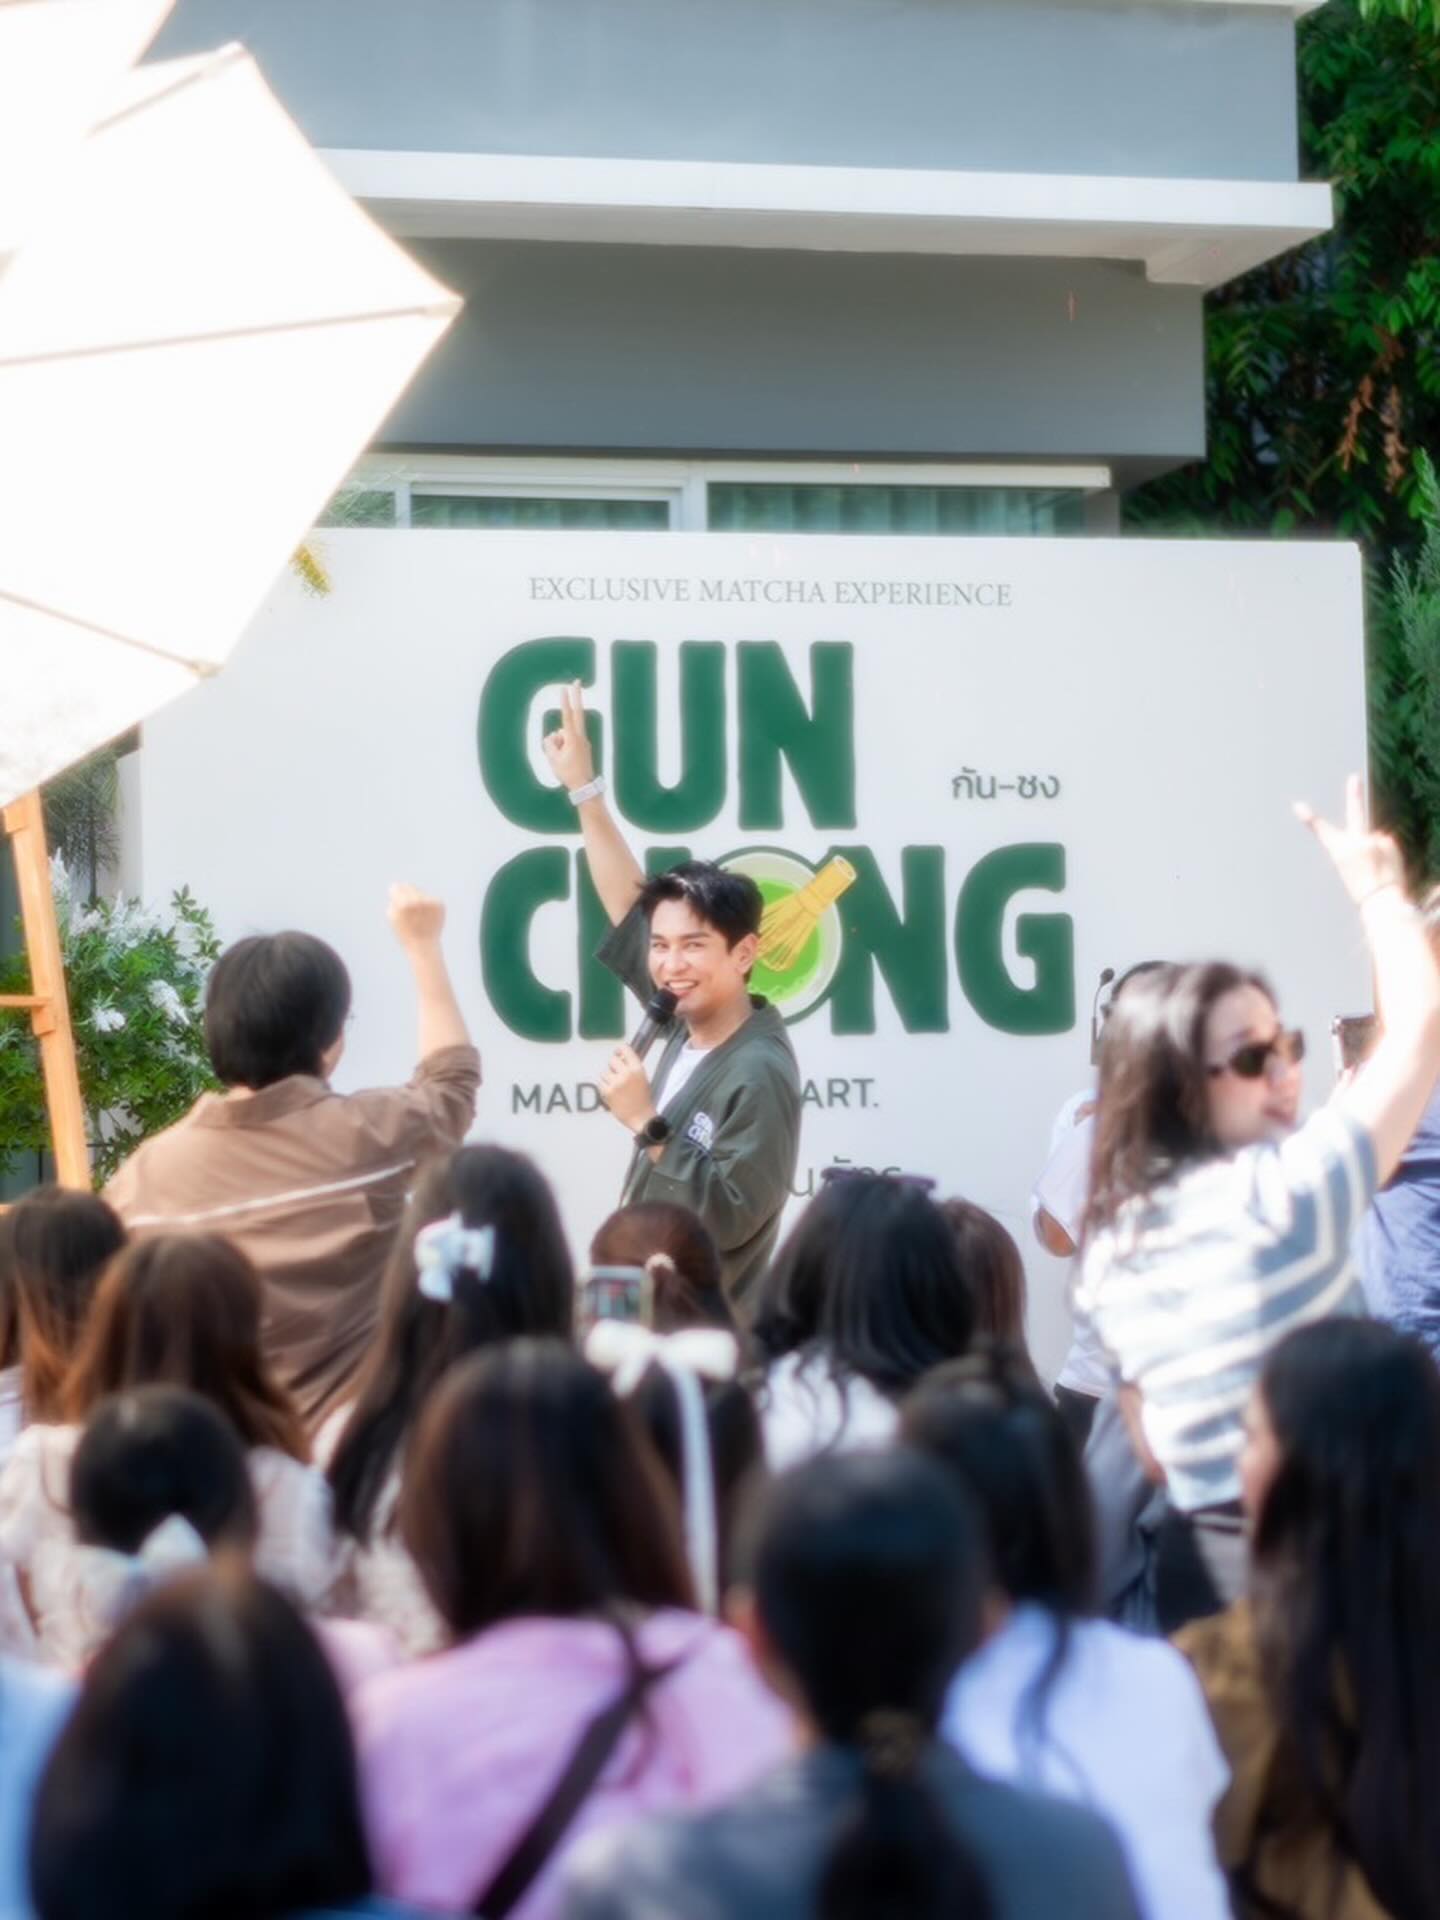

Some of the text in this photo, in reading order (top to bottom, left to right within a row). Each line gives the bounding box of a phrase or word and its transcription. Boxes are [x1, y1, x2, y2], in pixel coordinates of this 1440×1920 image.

[530, 577, 1013, 607] EXCLUSIVE MATCHA EXPERIENCE
[477, 636, 857, 834] GUN
[512, 1078, 879, 1114] MAD ART.
